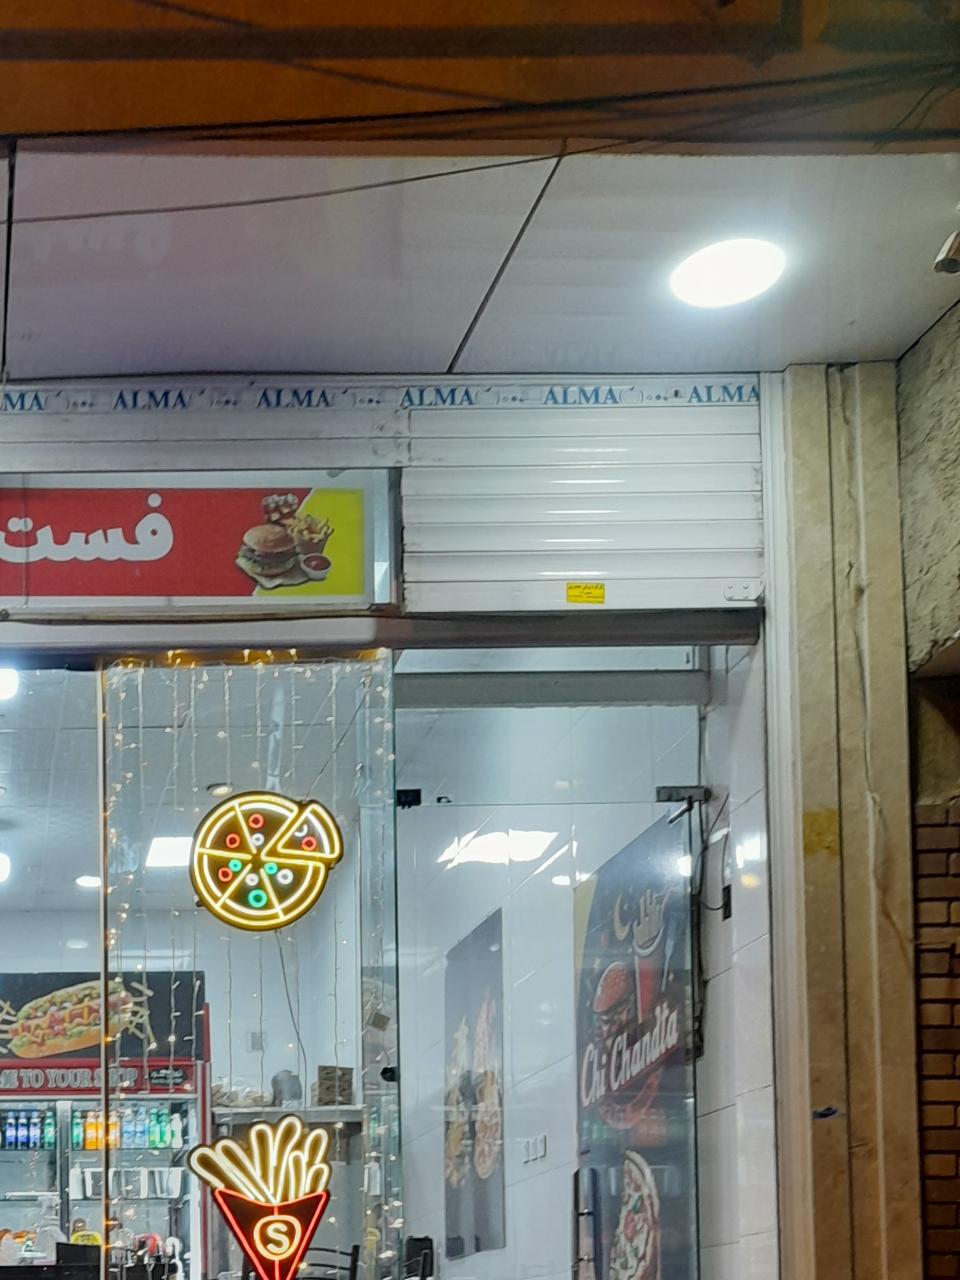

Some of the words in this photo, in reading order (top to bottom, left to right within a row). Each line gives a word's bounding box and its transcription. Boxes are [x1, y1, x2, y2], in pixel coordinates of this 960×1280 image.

[113, 389, 189, 410] ALMA
[256, 387, 332, 408] ALMA
[399, 386, 475, 406] ALMA
[543, 386, 620, 405] ALMA
[687, 384, 759, 402] ALMA
[581, 1042, 606, 1107] Chi
[610, 1001, 679, 1091] Chandta
[20, 1068, 44, 1088] TO
[46, 1068, 92, 1088] YOUR
